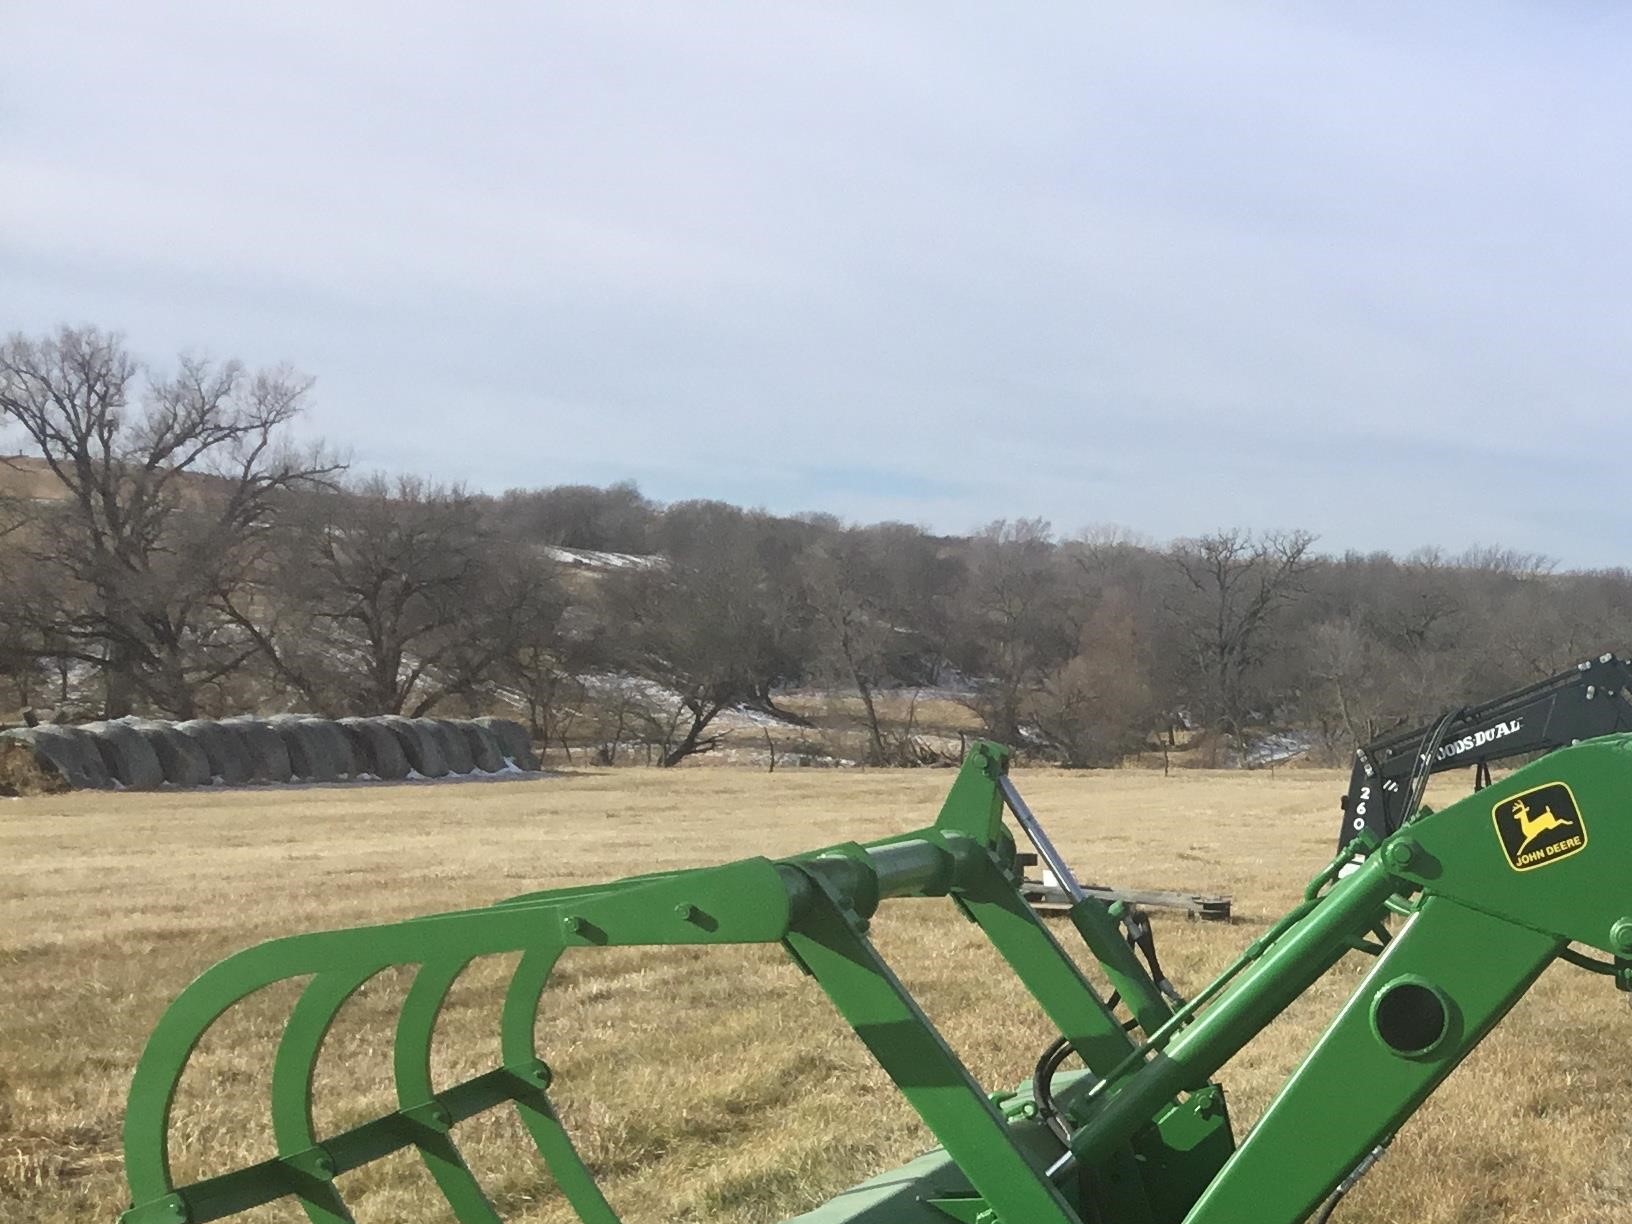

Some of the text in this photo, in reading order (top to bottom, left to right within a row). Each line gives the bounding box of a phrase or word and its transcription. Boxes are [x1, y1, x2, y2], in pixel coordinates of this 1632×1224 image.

[1353, 786, 1371, 831] 260
[1516, 836, 1582, 867] JOHN DEERE
